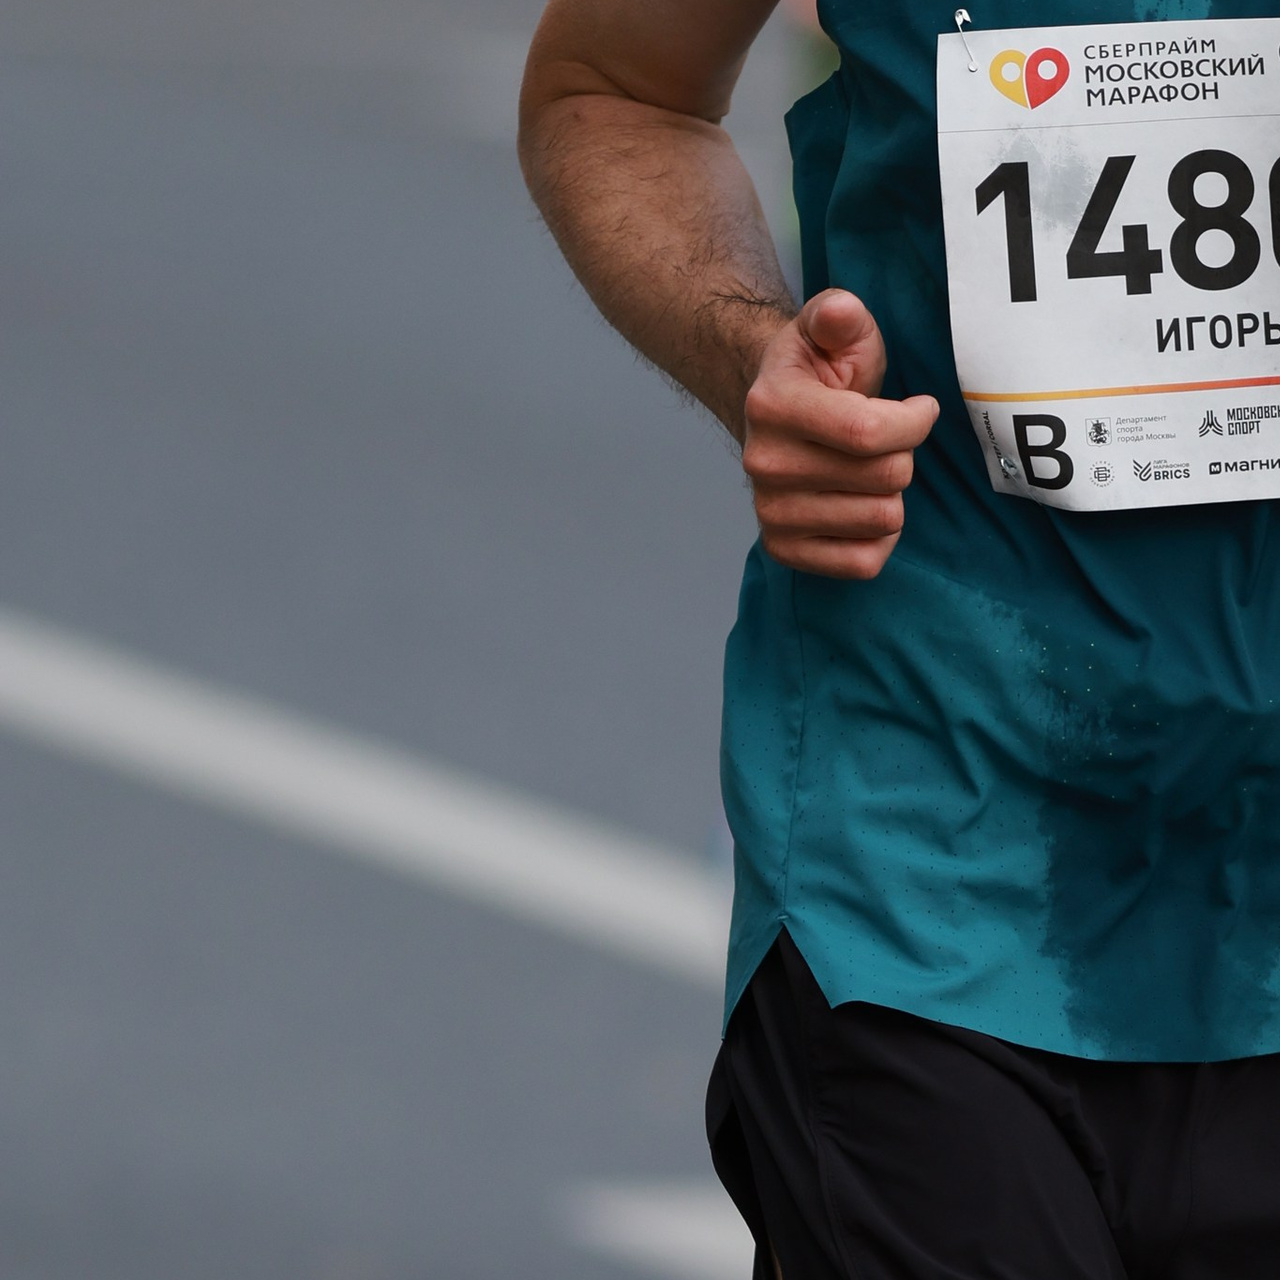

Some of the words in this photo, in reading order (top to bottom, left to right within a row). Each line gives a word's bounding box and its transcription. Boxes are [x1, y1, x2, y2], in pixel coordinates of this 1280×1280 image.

[1083, 36, 1217, 60] СБЕРПРАЙМ
[1084, 53, 1266, 84] МОСКОВСКИЙ
[1086, 81, 1220, 108] МАРАФОН
[981, 410, 996, 440] CORRAL
[1115, 415, 1167, 426] Департамент
[1227, 420, 1261, 436] СПОРТ
[1116, 425, 1143, 435] спорта
[1117, 435, 1144, 443] города
[1145, 433, 1176, 441] Москвы
[1154, 468, 1191, 481] BRICS
